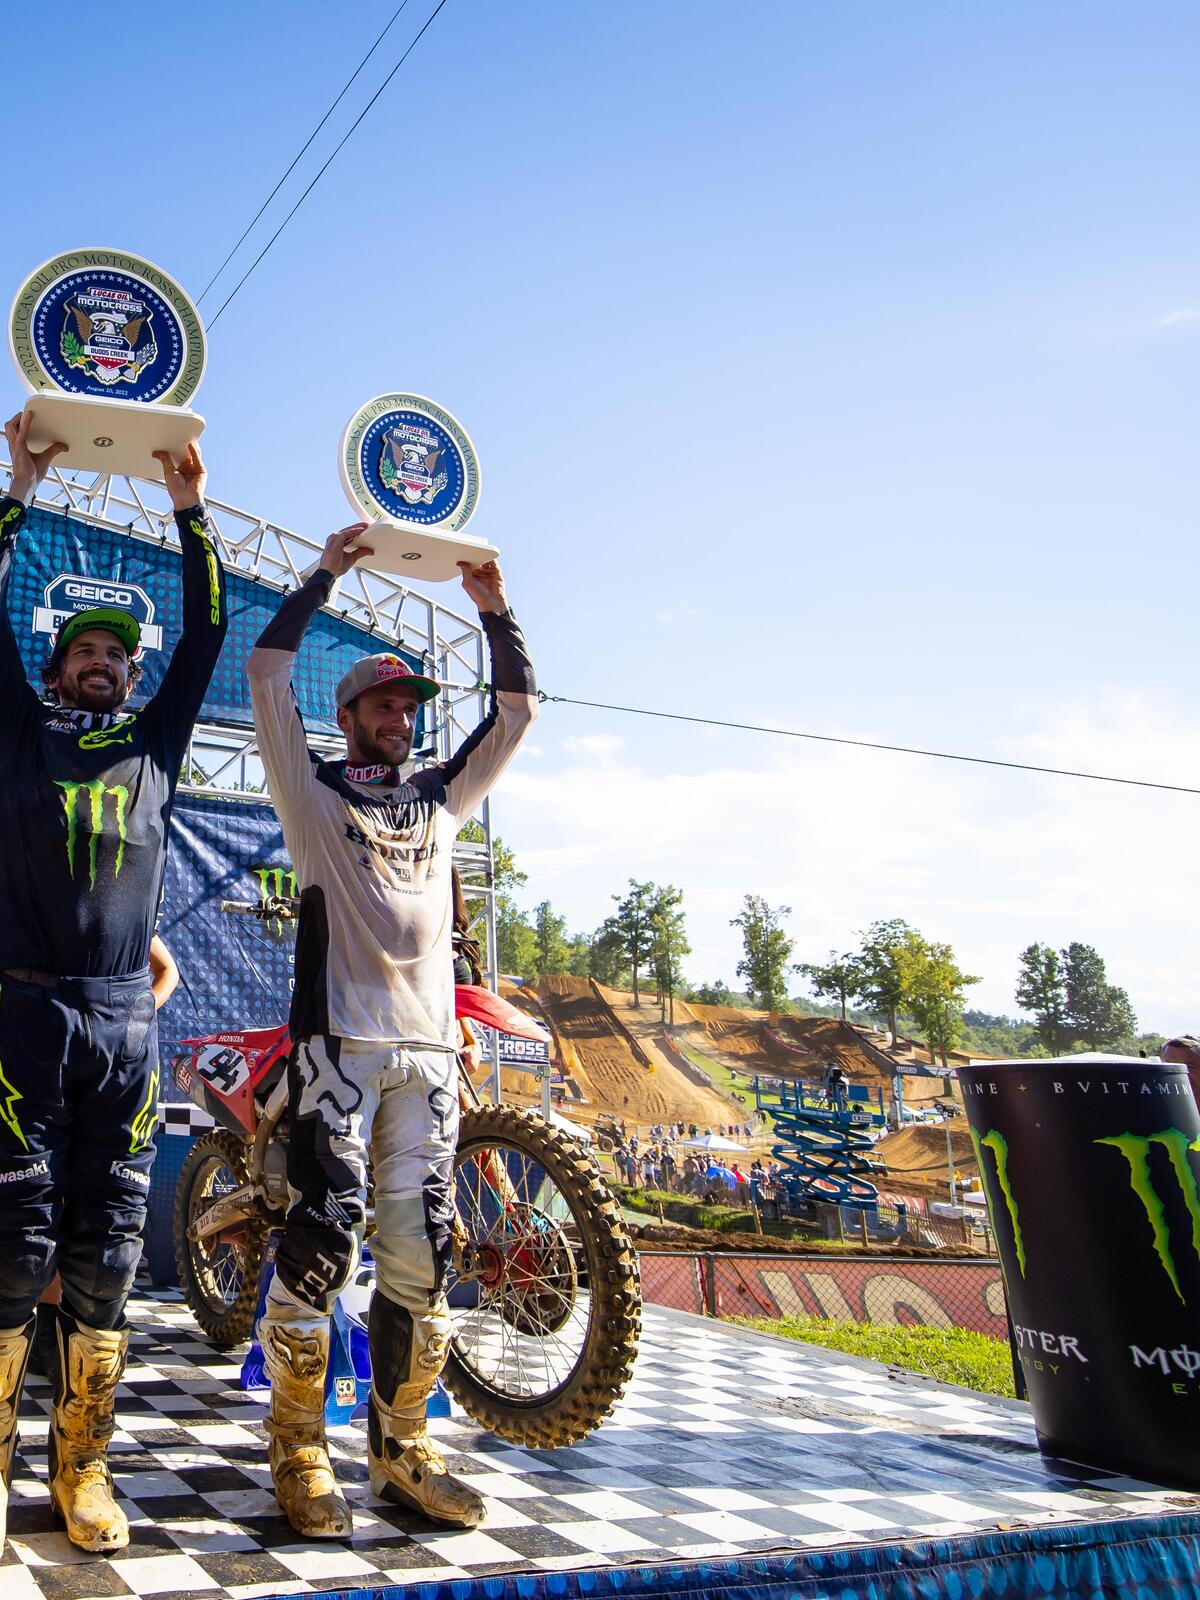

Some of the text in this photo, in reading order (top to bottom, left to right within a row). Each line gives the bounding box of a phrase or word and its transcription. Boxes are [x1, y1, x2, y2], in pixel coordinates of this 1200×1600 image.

[92, 289, 130, 301] LUCAS OIL
[77, 297, 143, 313] MOTOCROSS
[15, 254, 202, 403] 2022 LUCAS OIL PRO MOTOCROSS CHAMPIONSHIP
[95, 336, 124, 345] GEICO
[110, 349, 129, 358] CREEK
[393, 430, 439, 446] MOTOCROSS
[348, 430, 360, 468] LUCAS
[356, 412, 373, 430] OIL
[372, 399, 392, 415] PRO
[394, 397, 458, 435] MOTOCROSS
[457, 436, 478, 523] CHAMPIONSHIP
[64, 582, 132, 606] GEICO
[74, 620, 132, 632] Kawasaki
[46, 718, 77, 730] Airoh
[218, 1035, 245, 1044] HONDA
[295, 1252, 338, 1306] FOX
[338, 1380, 354, 1395] 50
